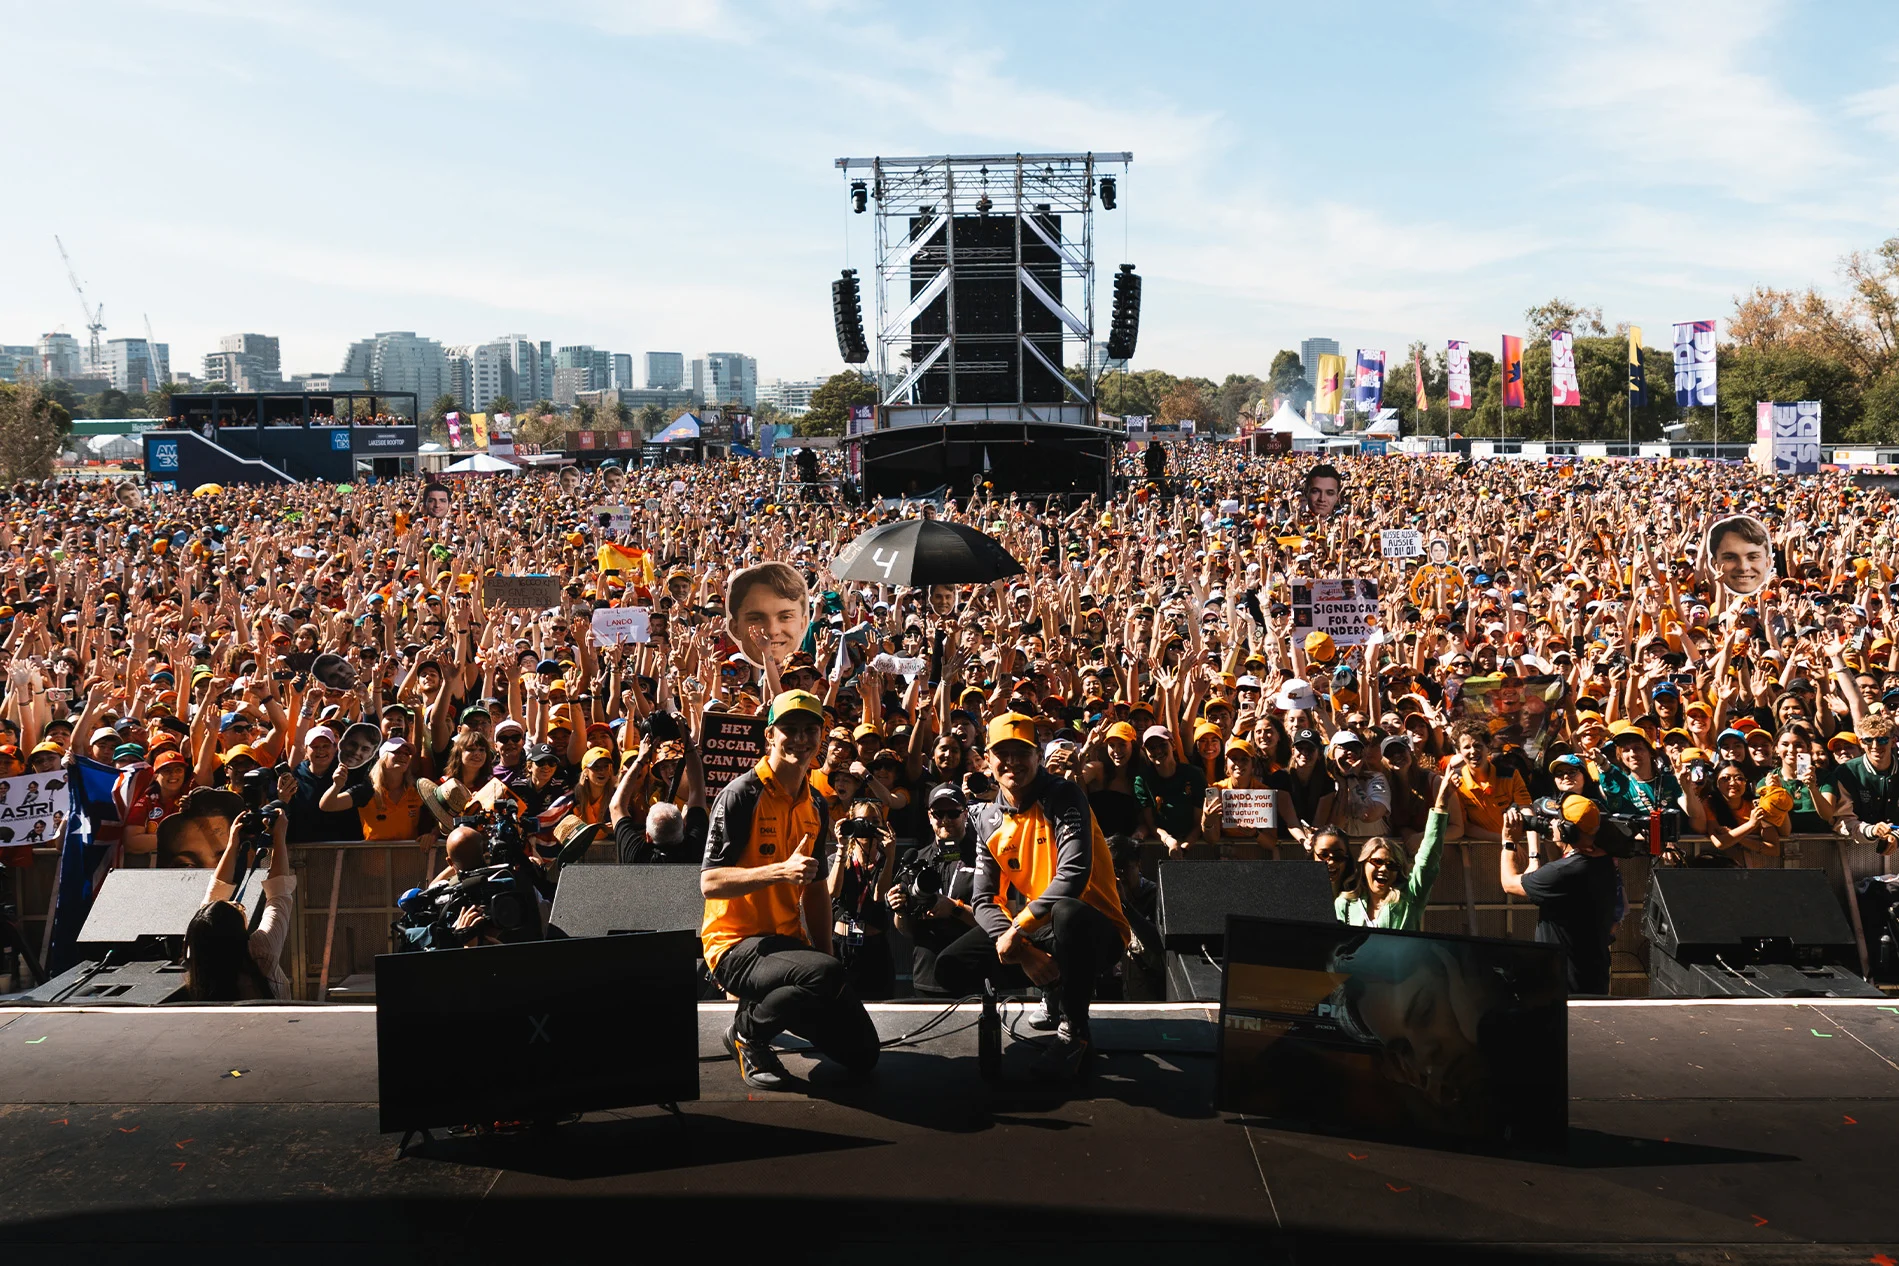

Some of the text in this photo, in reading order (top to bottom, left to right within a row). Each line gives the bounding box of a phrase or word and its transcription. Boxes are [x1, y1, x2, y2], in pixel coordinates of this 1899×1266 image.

[1382, 531, 1418, 539] AUSSIE AUSSIE
[872, 548, 899, 578] 4
[1313, 603, 1377, 614] SIGNED CAP
[606, 618, 633, 627] LANDO
[1328, 615, 1361, 625] FOR A
[1317, 625, 1366, 636] KINDER?
[720, 723, 752, 735] HEY
[706, 738, 761, 755] OSCAR,
[702, 754, 759, 768] CAN WE
[707, 770, 744, 782] SWA
[1254, 794, 1271, 802] your
